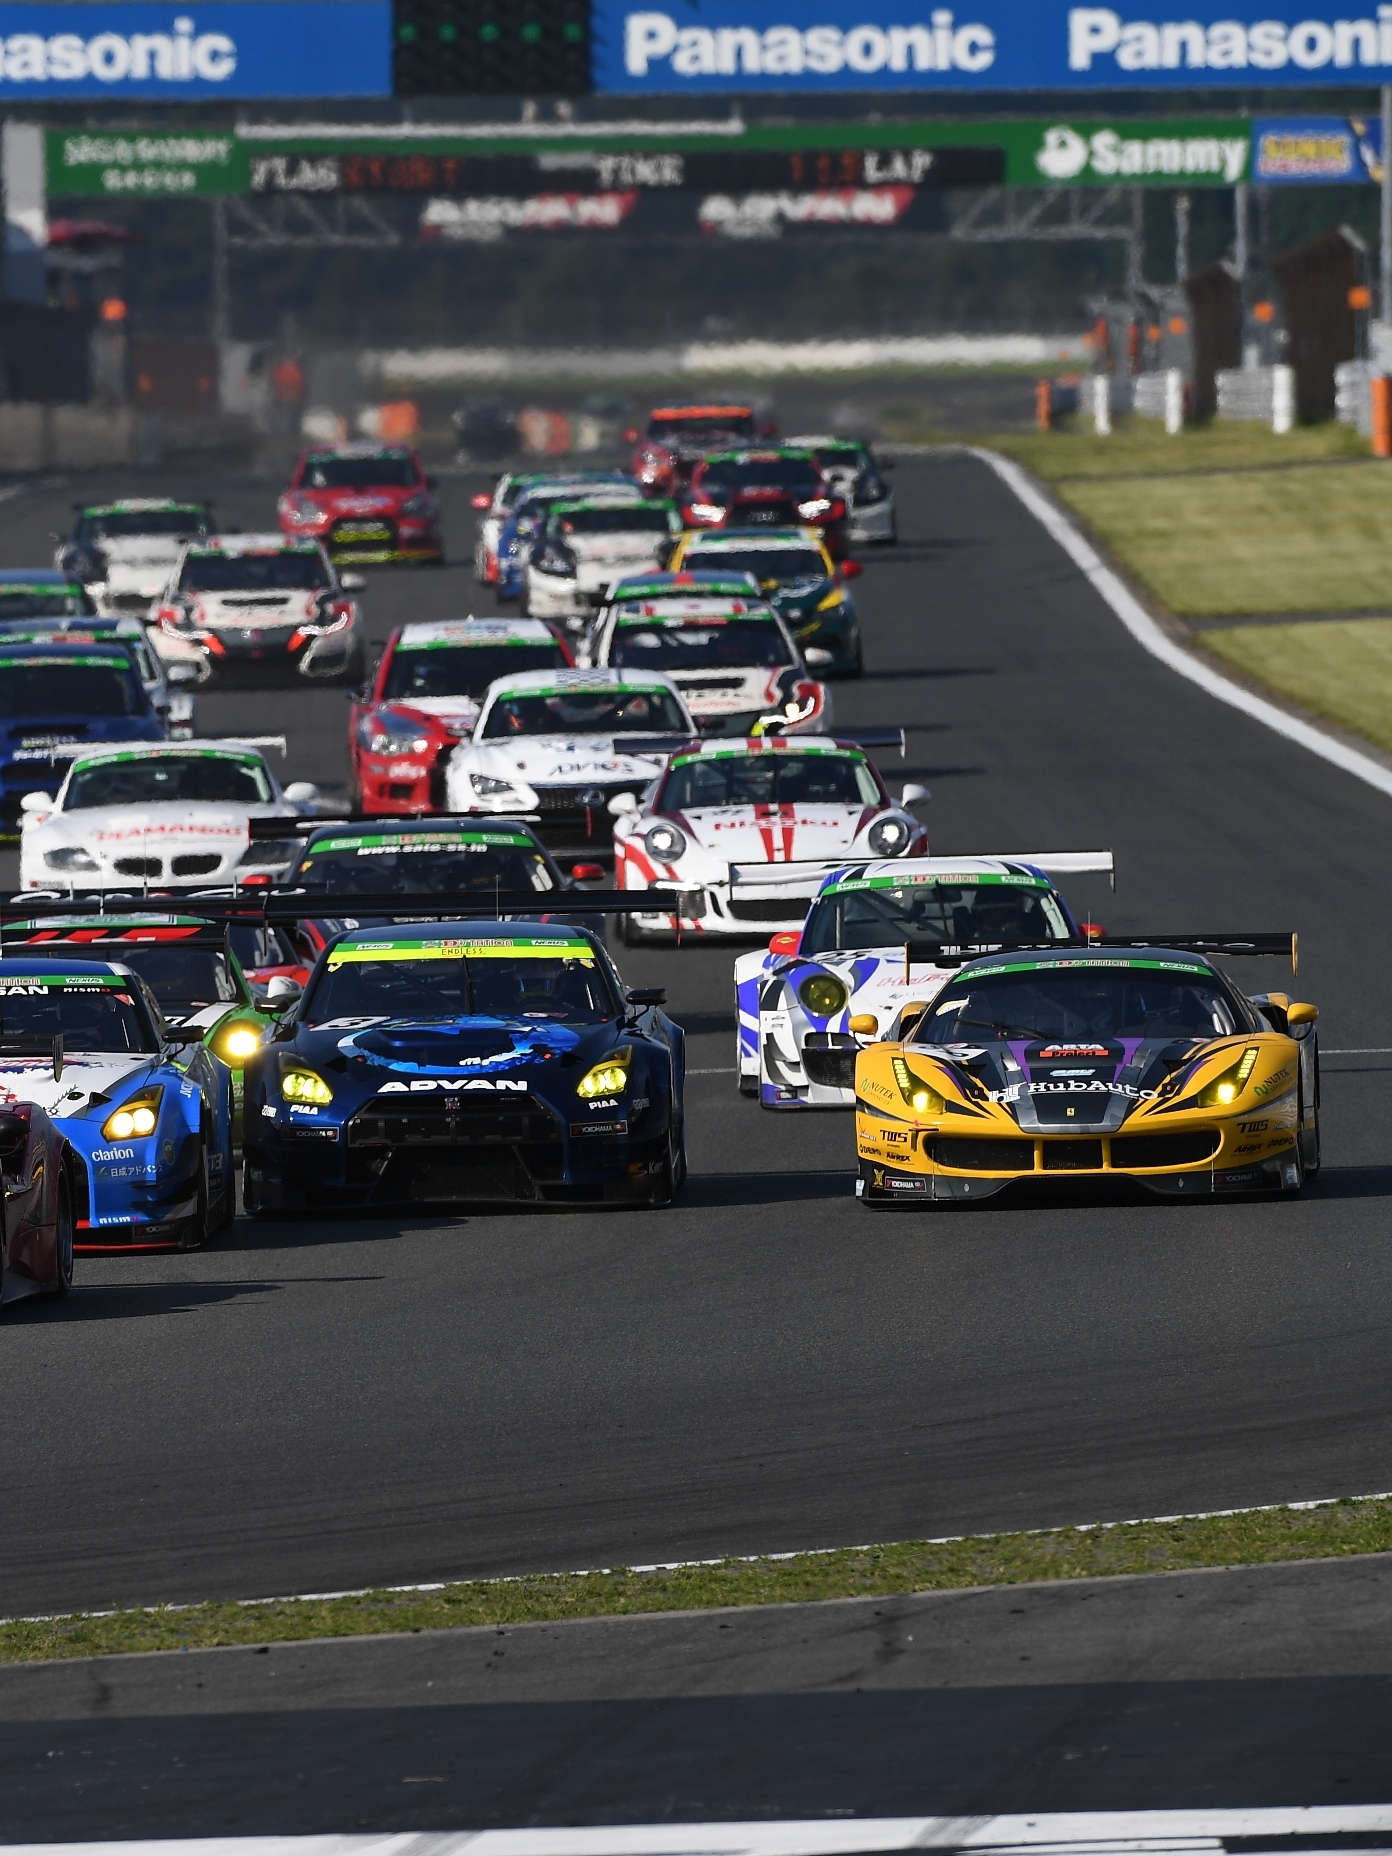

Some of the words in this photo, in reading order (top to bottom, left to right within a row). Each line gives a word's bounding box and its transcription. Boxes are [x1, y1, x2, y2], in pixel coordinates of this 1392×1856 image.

[623, 8, 995, 77] Panasonic
[1089, 128, 1248, 183] Sammy
[863, 149, 934, 184] LAP
[441, 947, 484, 956] ENDLESS
[325, 1017, 374, 1028] 3
[1044, 1043, 1105, 1051] ARTA
[1264, 1068, 1290, 1086] NUTEK
[377, 1079, 528, 1093] ADVAN
[868, 1081, 897, 1100] NUTEK
[1027, 1079, 1159, 1100] HubAuto
[289, 1104, 318, 1115] PIAA
[588, 1099, 619, 1110] PIAA
[581, 1125, 613, 1134] YOKOHAMA
[879, 1129, 908, 1143] TWS
[1225, 1173, 1254, 1182] YOKOHAMA
[99, 1215, 140, 1225] nismo
